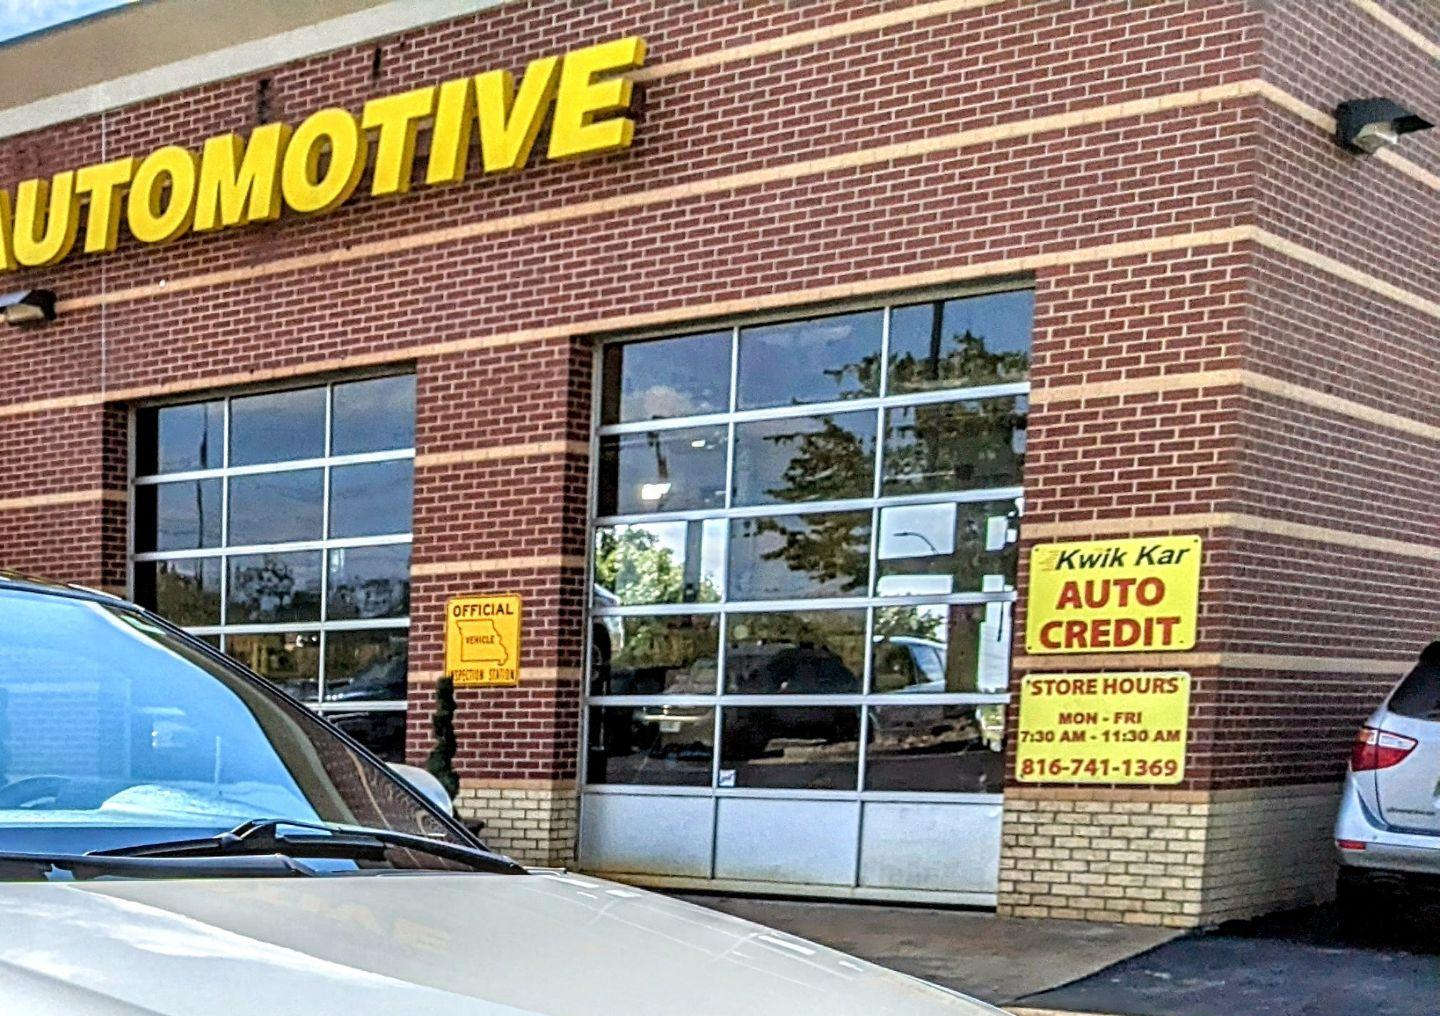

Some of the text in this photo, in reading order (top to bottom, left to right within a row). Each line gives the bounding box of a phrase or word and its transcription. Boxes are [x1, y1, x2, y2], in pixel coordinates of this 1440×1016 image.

[1055, 544, 1190, 571] Kwik Kar
[1055, 577, 1166, 610] AUTO
[453, 603, 514, 617] OFFICIAL
[465, 635, 495, 645] VEHICLE
[1040, 616, 1181, 649] CREDIT
[1031, 677, 1179, 696] STORE HOURS
[1058, 712, 1098, 725] MON
[1113, 711, 1143, 724] FRI
[1020, 731, 1055, 743] 7:30
[1059, 731, 1087, 742] AM
[1101, 730, 1149, 743] 11:30
[1153, 730, 1181, 742] AM
[1021, 758, 1178, 777] 816-741-1369
